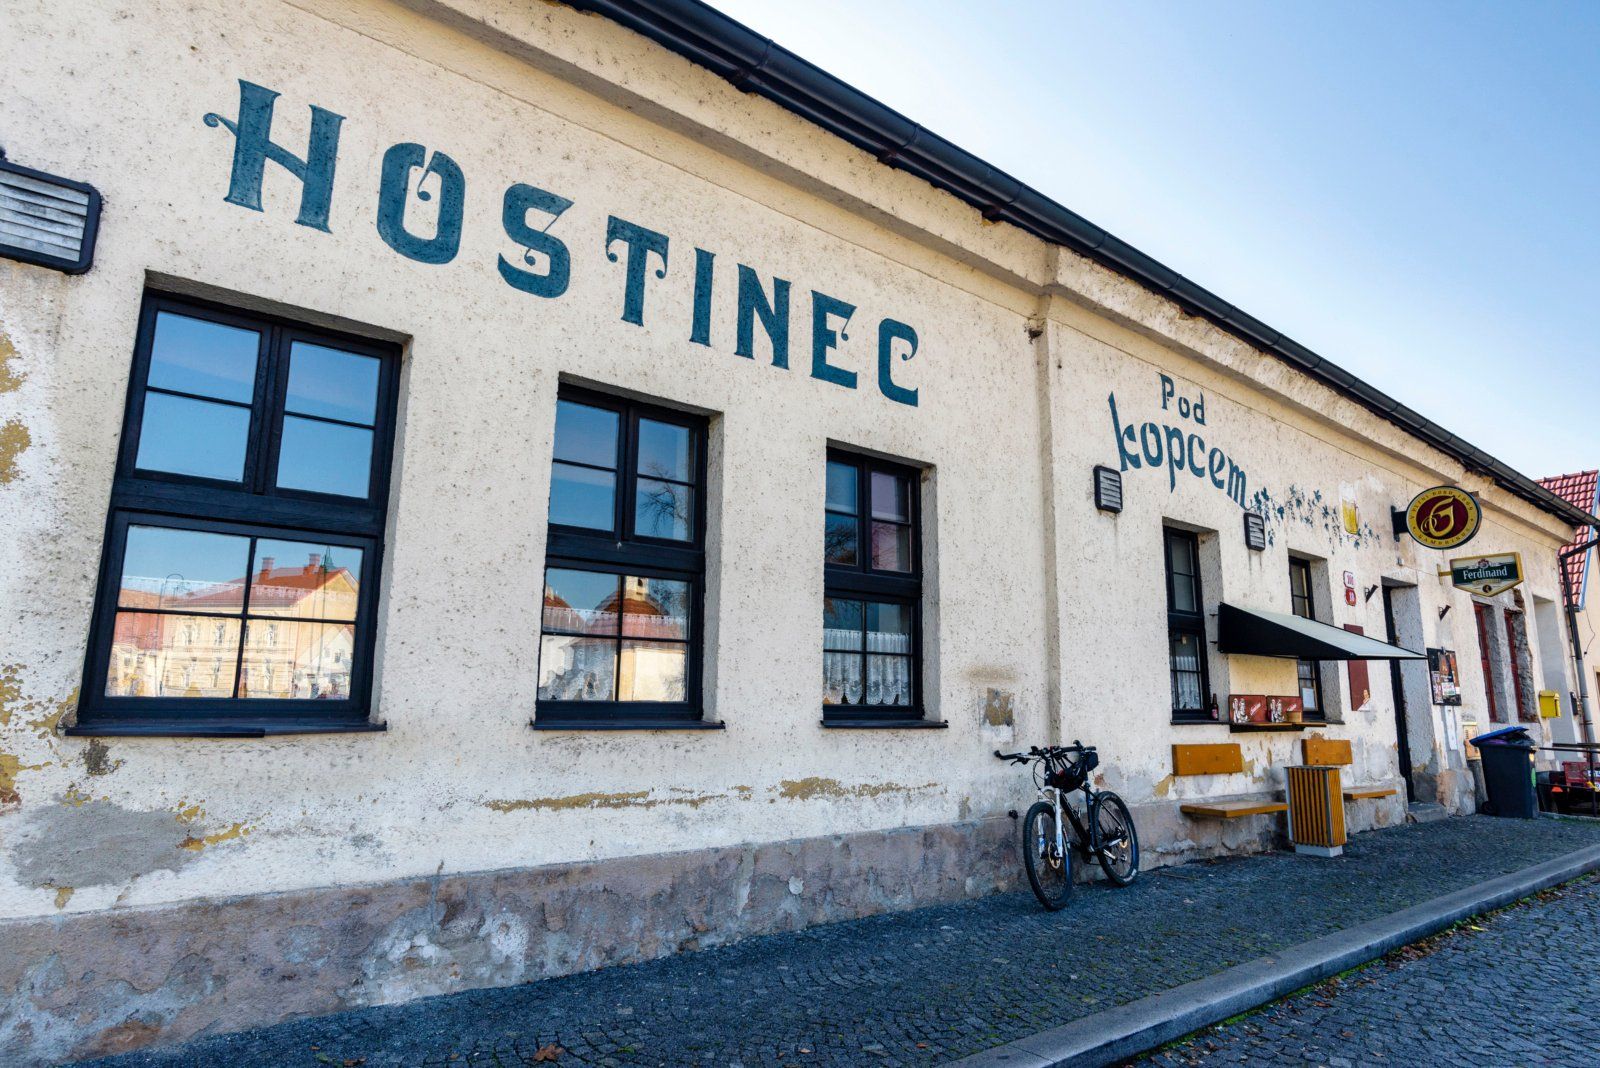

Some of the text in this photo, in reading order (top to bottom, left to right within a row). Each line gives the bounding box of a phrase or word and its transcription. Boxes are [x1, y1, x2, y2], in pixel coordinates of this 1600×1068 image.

[203, 79, 919, 406] HOSTINEC
[1156, 372, 1206, 426] Pod
[1108, 391, 1251, 510] kopcem
[1463, 566, 1508, 580] Ferdinand
